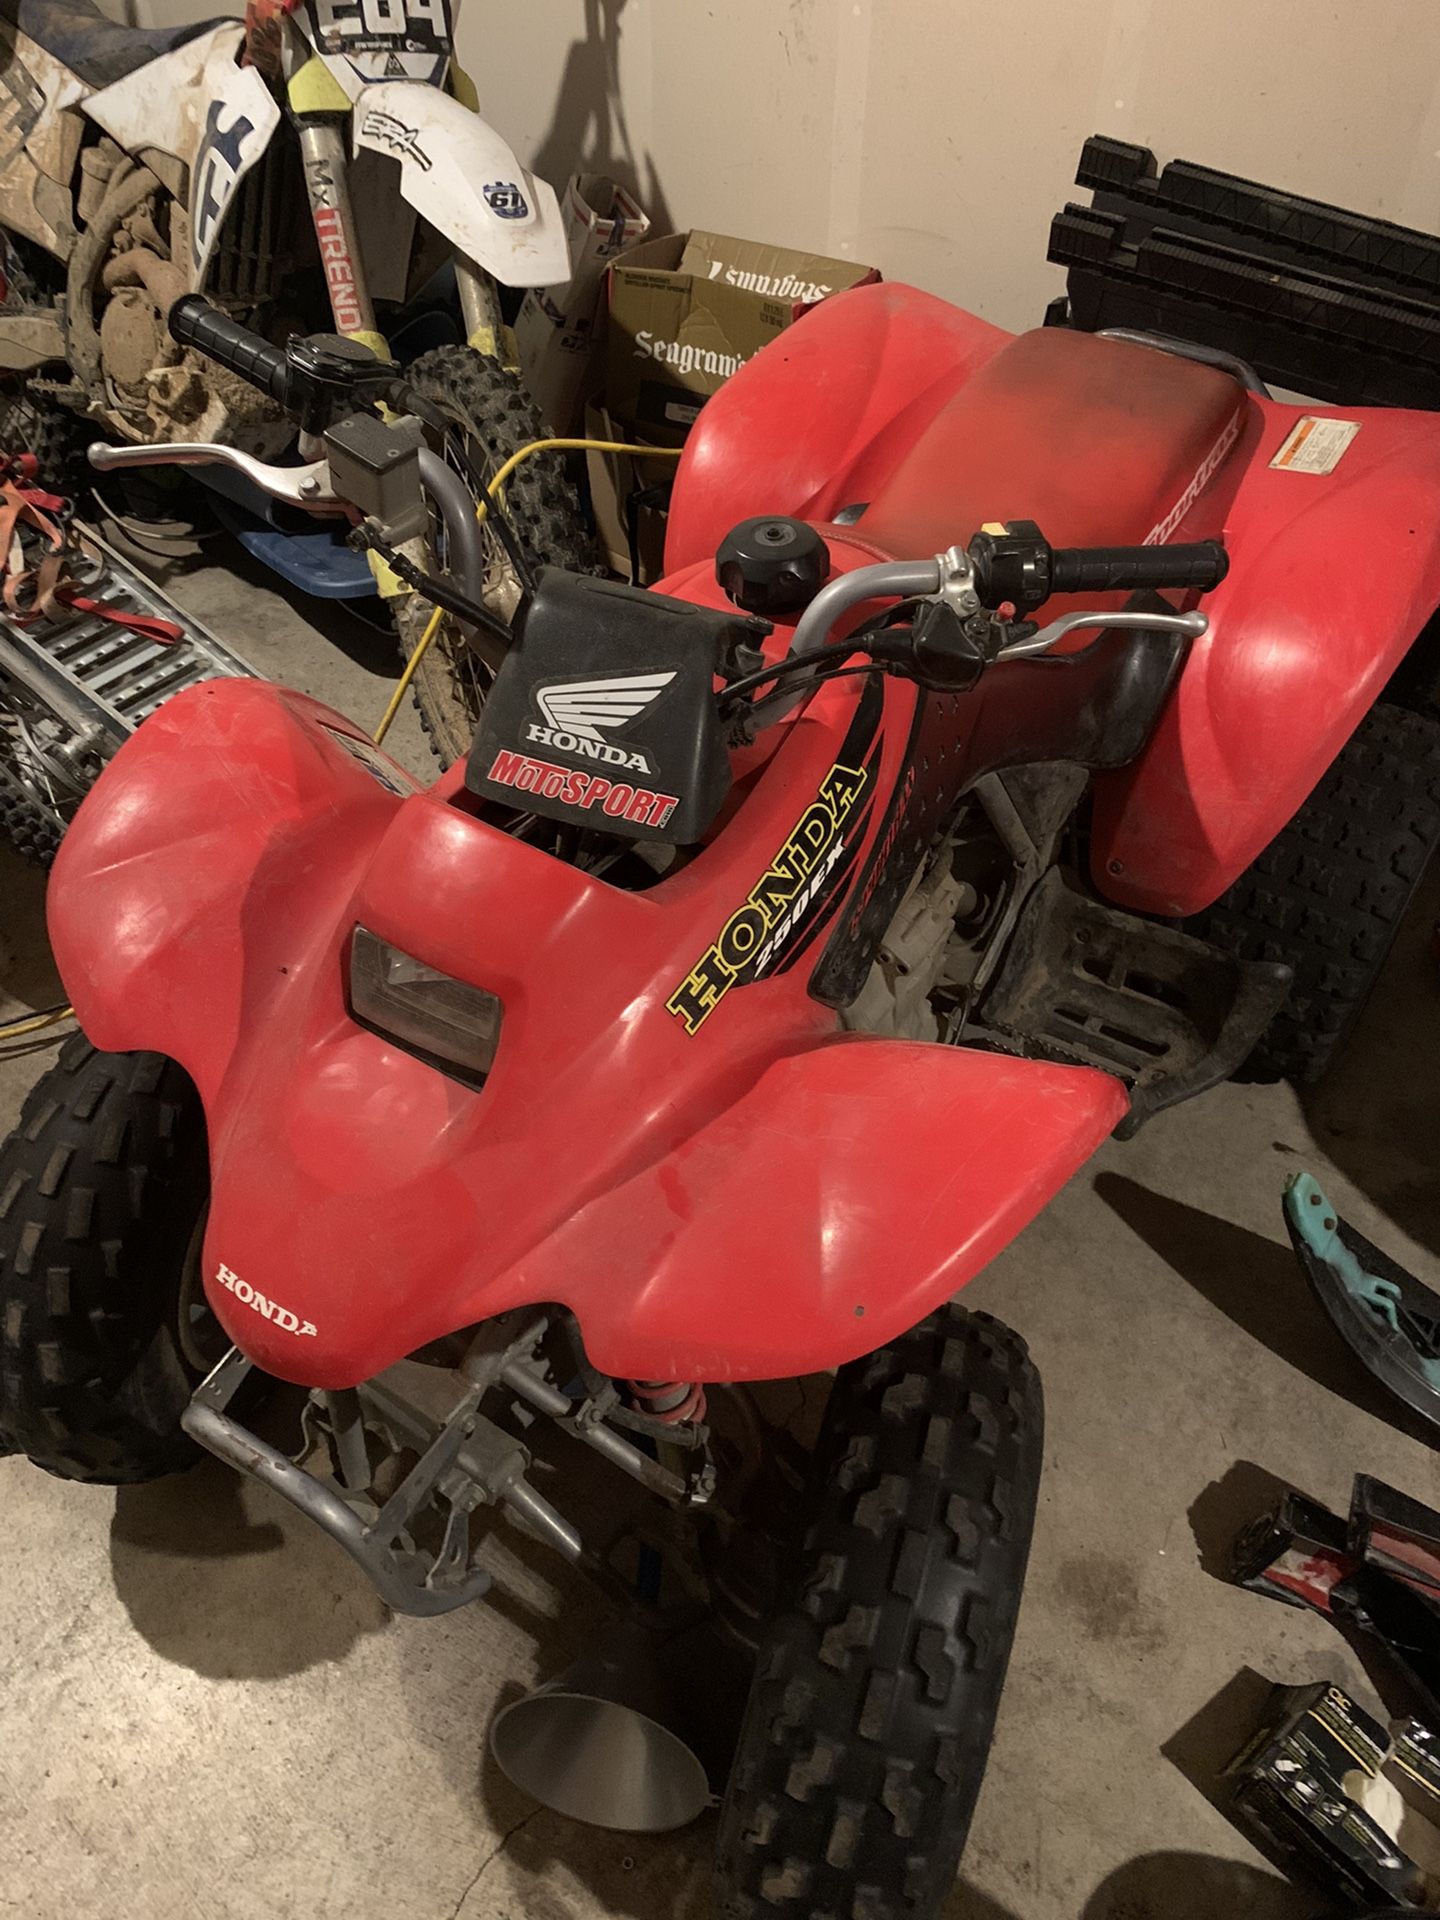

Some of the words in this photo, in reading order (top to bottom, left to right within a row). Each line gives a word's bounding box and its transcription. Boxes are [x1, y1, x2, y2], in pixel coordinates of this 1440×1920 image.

[525, 722, 652, 776] HONDA
[664, 763, 868, 1037] HONDA
[754, 833, 846, 979] 250EX
[215, 1262, 319, 1337] HONDA
